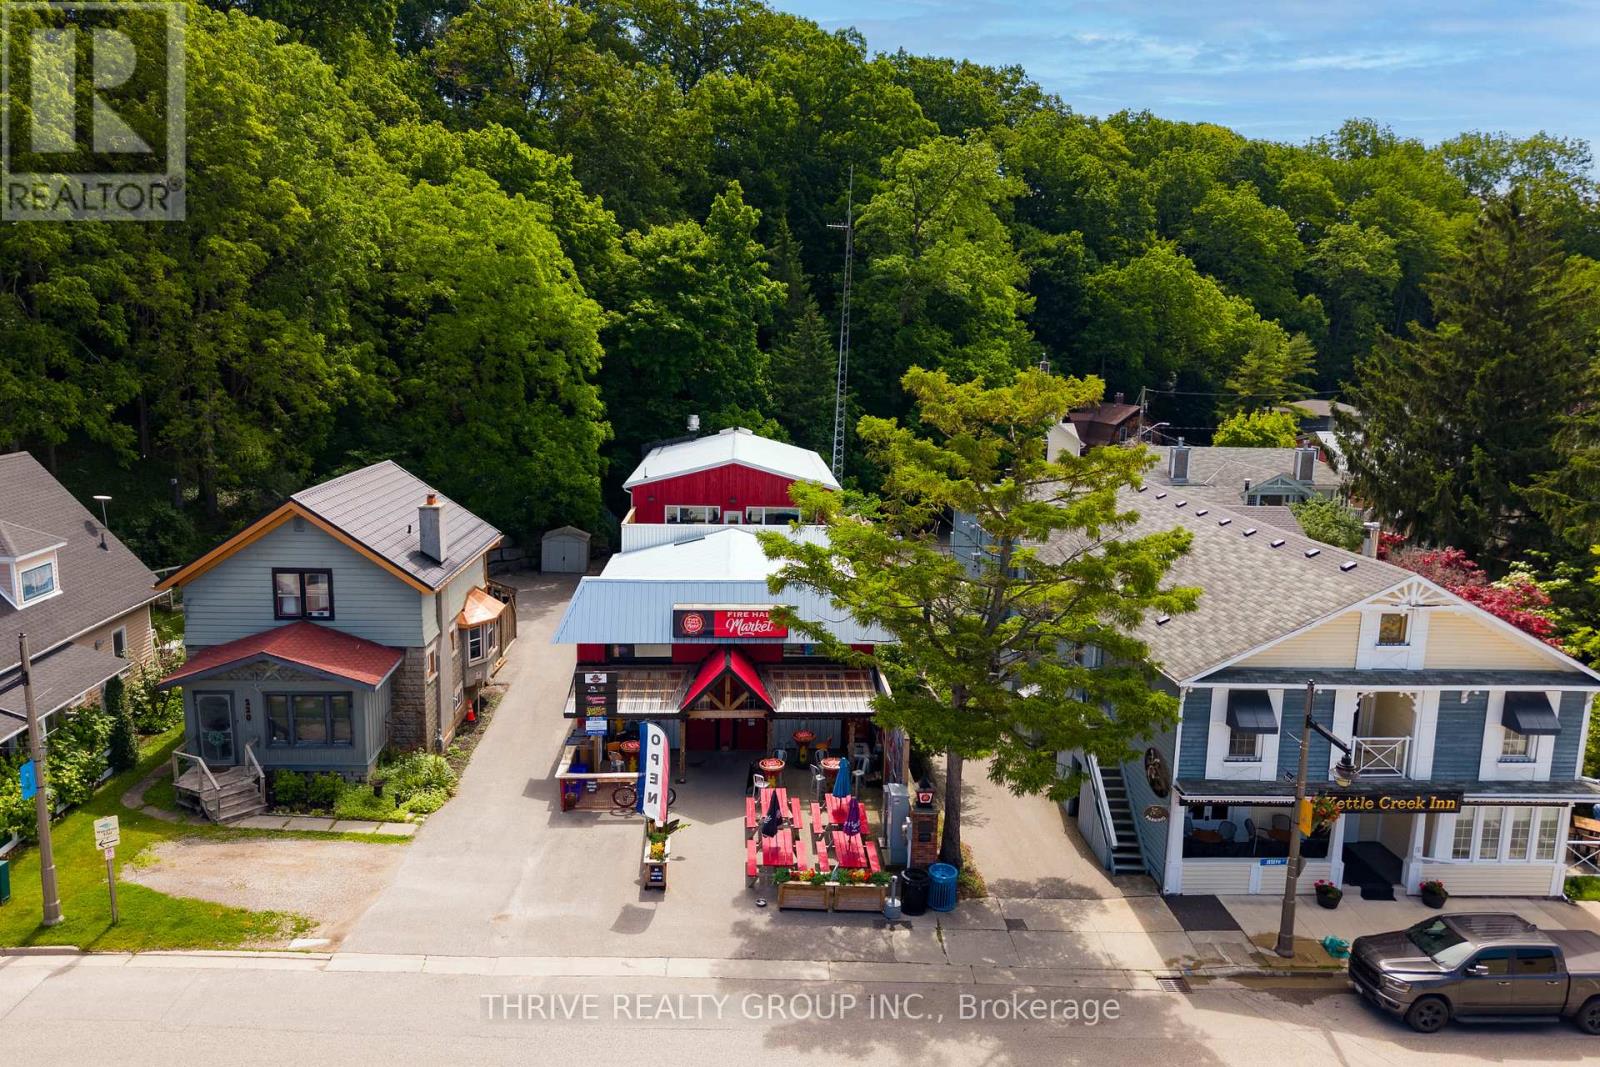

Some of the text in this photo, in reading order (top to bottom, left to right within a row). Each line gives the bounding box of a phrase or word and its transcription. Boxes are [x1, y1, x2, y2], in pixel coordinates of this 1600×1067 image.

[725, 618, 774, 636] Market
[1378, 796, 1426, 809] Creek
[1428, 796, 1456, 809] Inn
